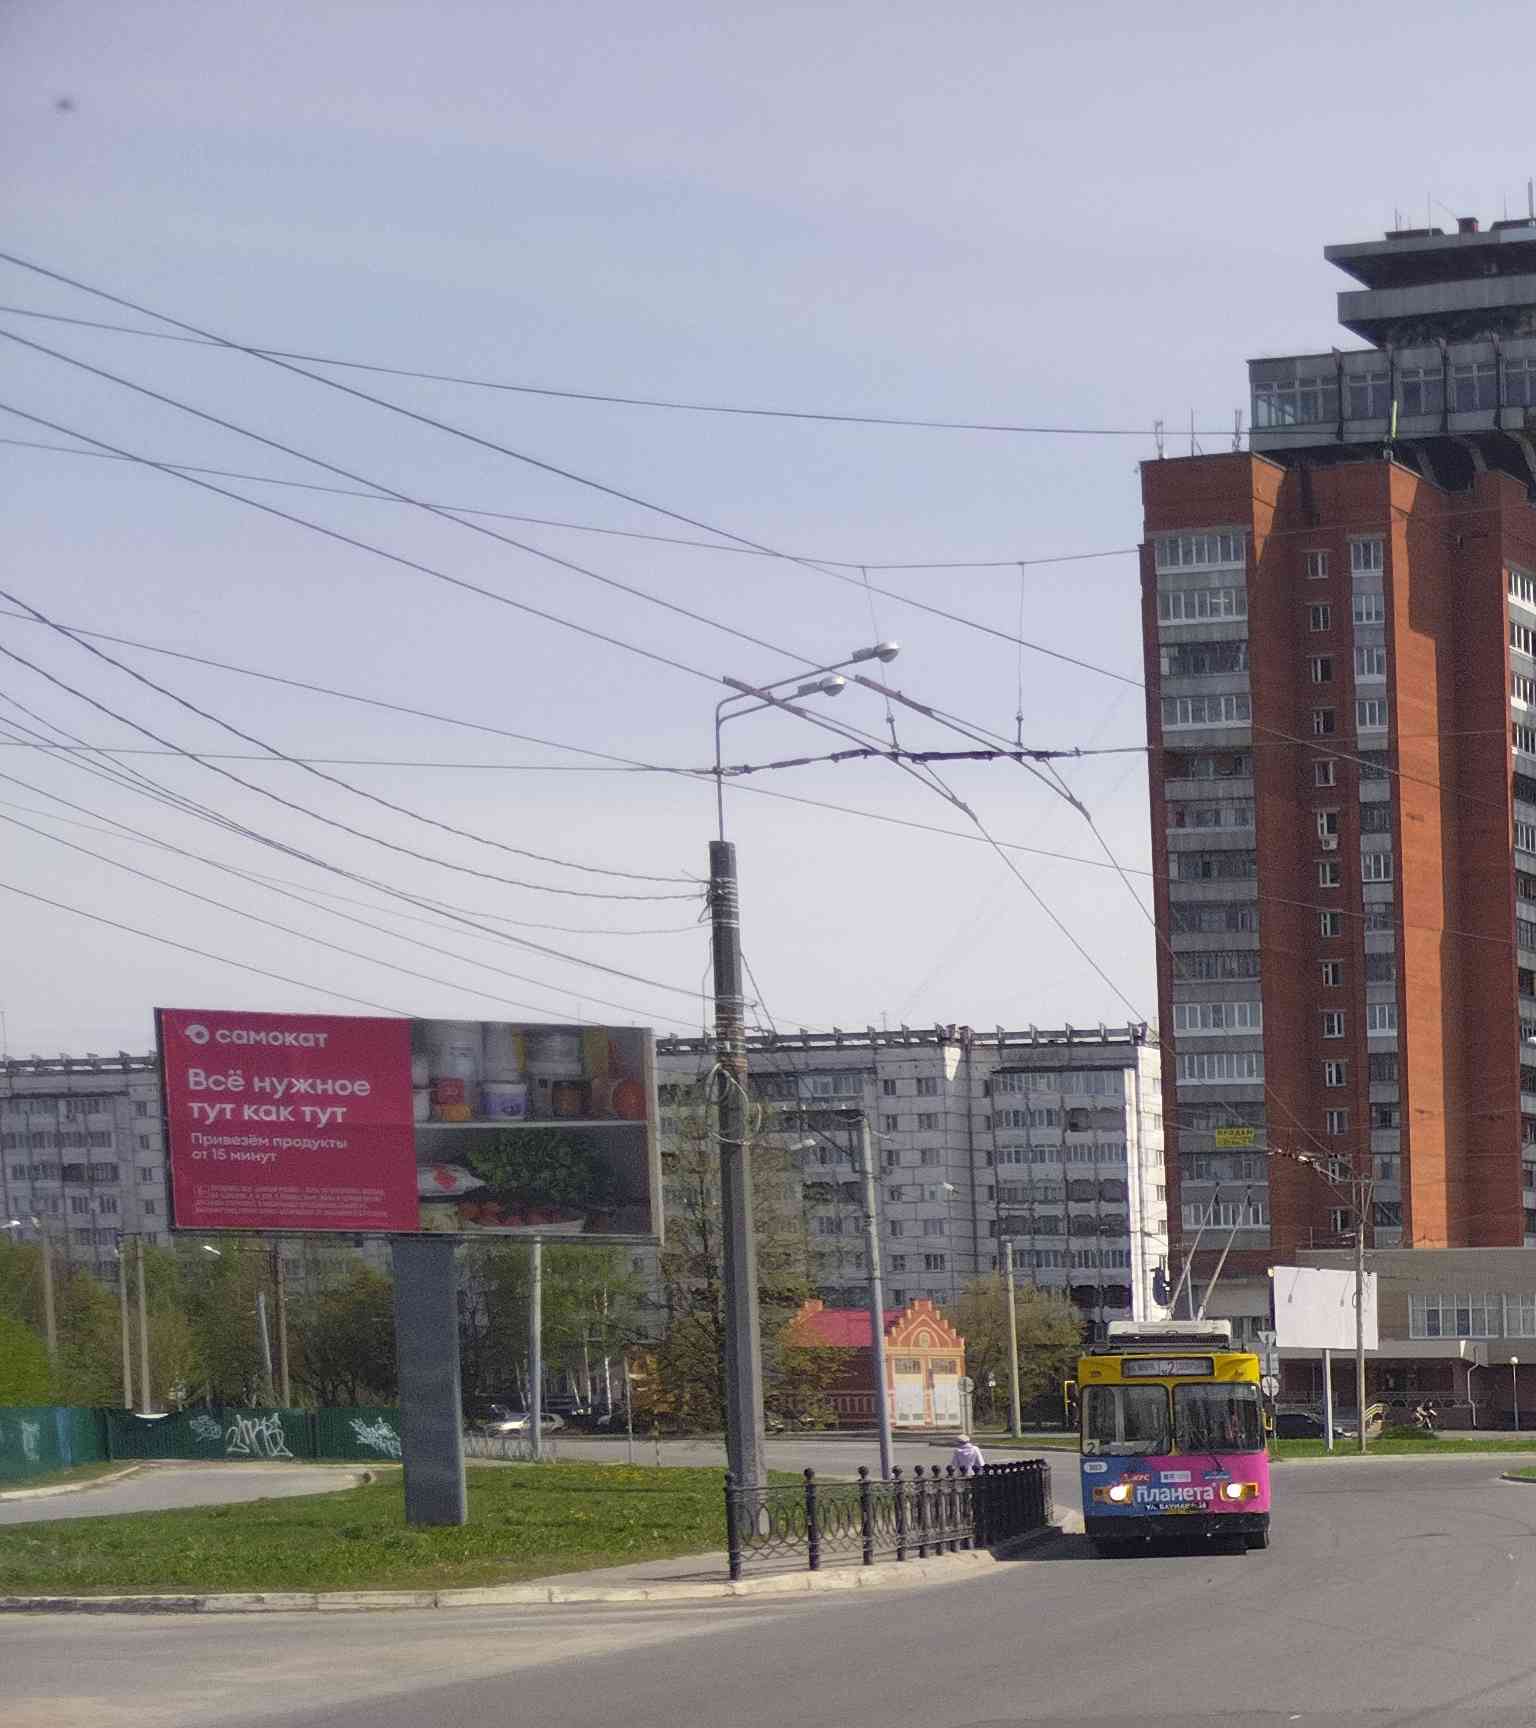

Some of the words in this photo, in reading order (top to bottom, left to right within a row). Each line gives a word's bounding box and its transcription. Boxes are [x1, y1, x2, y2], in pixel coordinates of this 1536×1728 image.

[215, 1028, 329, 1048] самокат
[188, 1067, 246, 1092] Всё
[252, 1075, 371, 1099] нужное
[188, 1102, 236, 1125] тут
[242, 1104, 295, 1122] как
[300, 1106, 347, 1128] тут
[191, 1132, 270, 1148] Привезём
[272, 1136, 348, 1150] продукты
[191, 1150, 208, 1161] от
[212, 1148, 227, 1161] 15
[230, 1151, 278, 1165] минут
